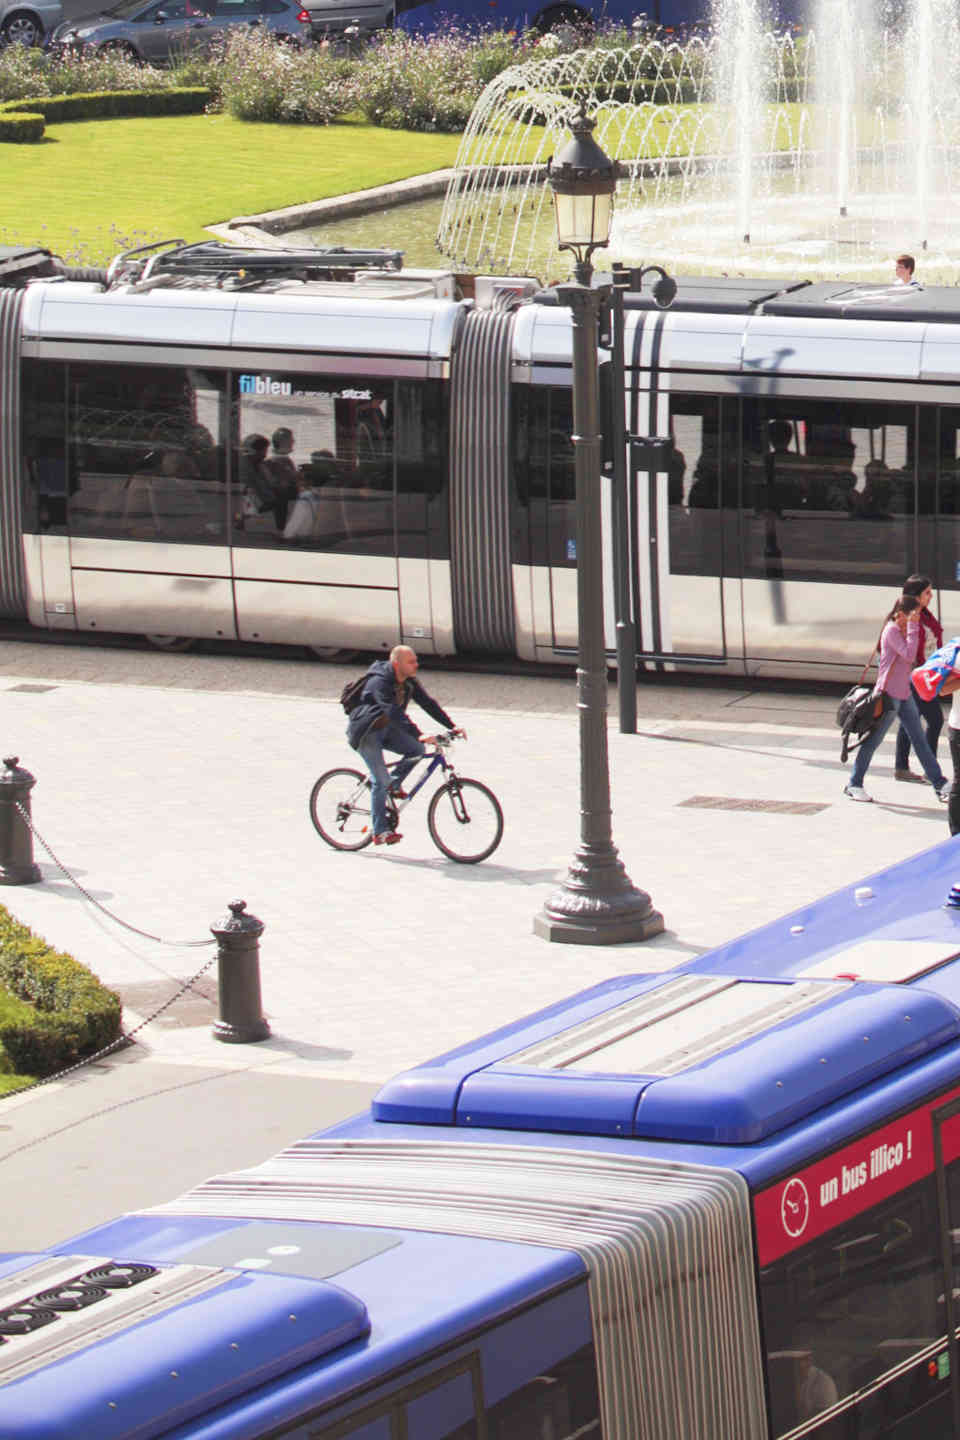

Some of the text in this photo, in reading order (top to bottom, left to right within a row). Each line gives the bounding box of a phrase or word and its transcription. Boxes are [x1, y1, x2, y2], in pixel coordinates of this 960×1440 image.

[238, 374, 292, 396] filbleu
[820, 1176, 839, 1208] un
[841, 1161, 868, 1196] bus
[870, 1141, 904, 1180] illico
